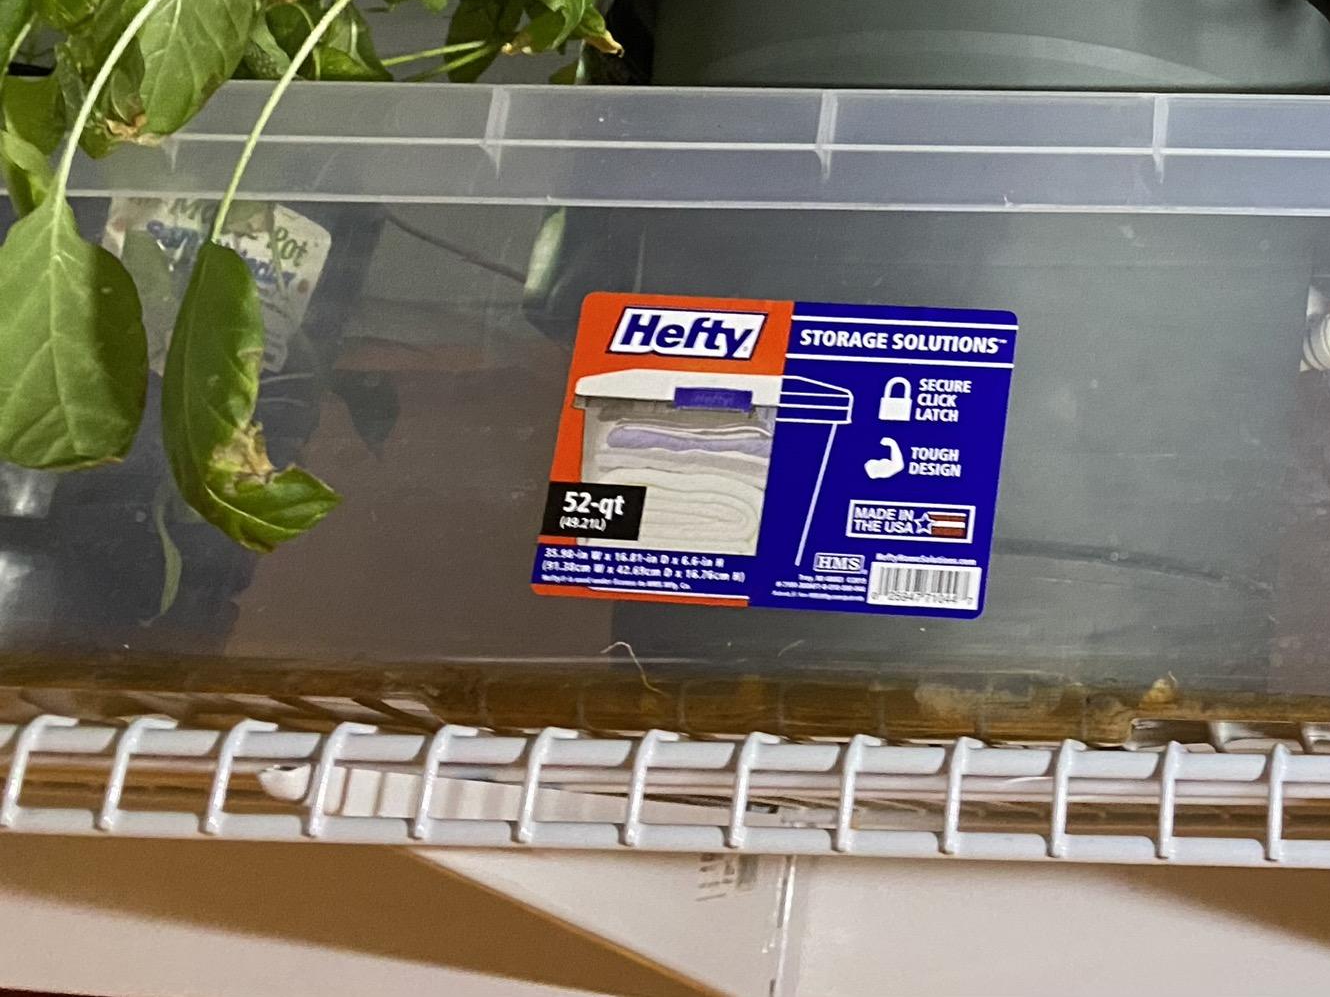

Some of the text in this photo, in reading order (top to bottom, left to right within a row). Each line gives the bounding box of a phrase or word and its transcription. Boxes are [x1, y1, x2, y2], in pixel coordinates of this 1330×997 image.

[620, 314, 754, 359] Hefty
[800, 329, 889, 349] STORAGE
[918, 378, 973, 393] SECURE
[917, 394, 957, 407] CLICK
[915, 408, 959, 422] LATCH
[911, 447, 959, 462] TOUGH
[908, 462, 961, 477] DESIGN
[562, 490, 625, 520] 52-qt
[854, 506, 914, 521] MADE IN
[854, 519, 914, 534] THE USA
[591, 551, 603, 561] W
[660, 554, 670, 564] D
[817, 556, 861, 571] HMS
[594, 563, 605, 573] W
[663, 567, 673, 577] D
